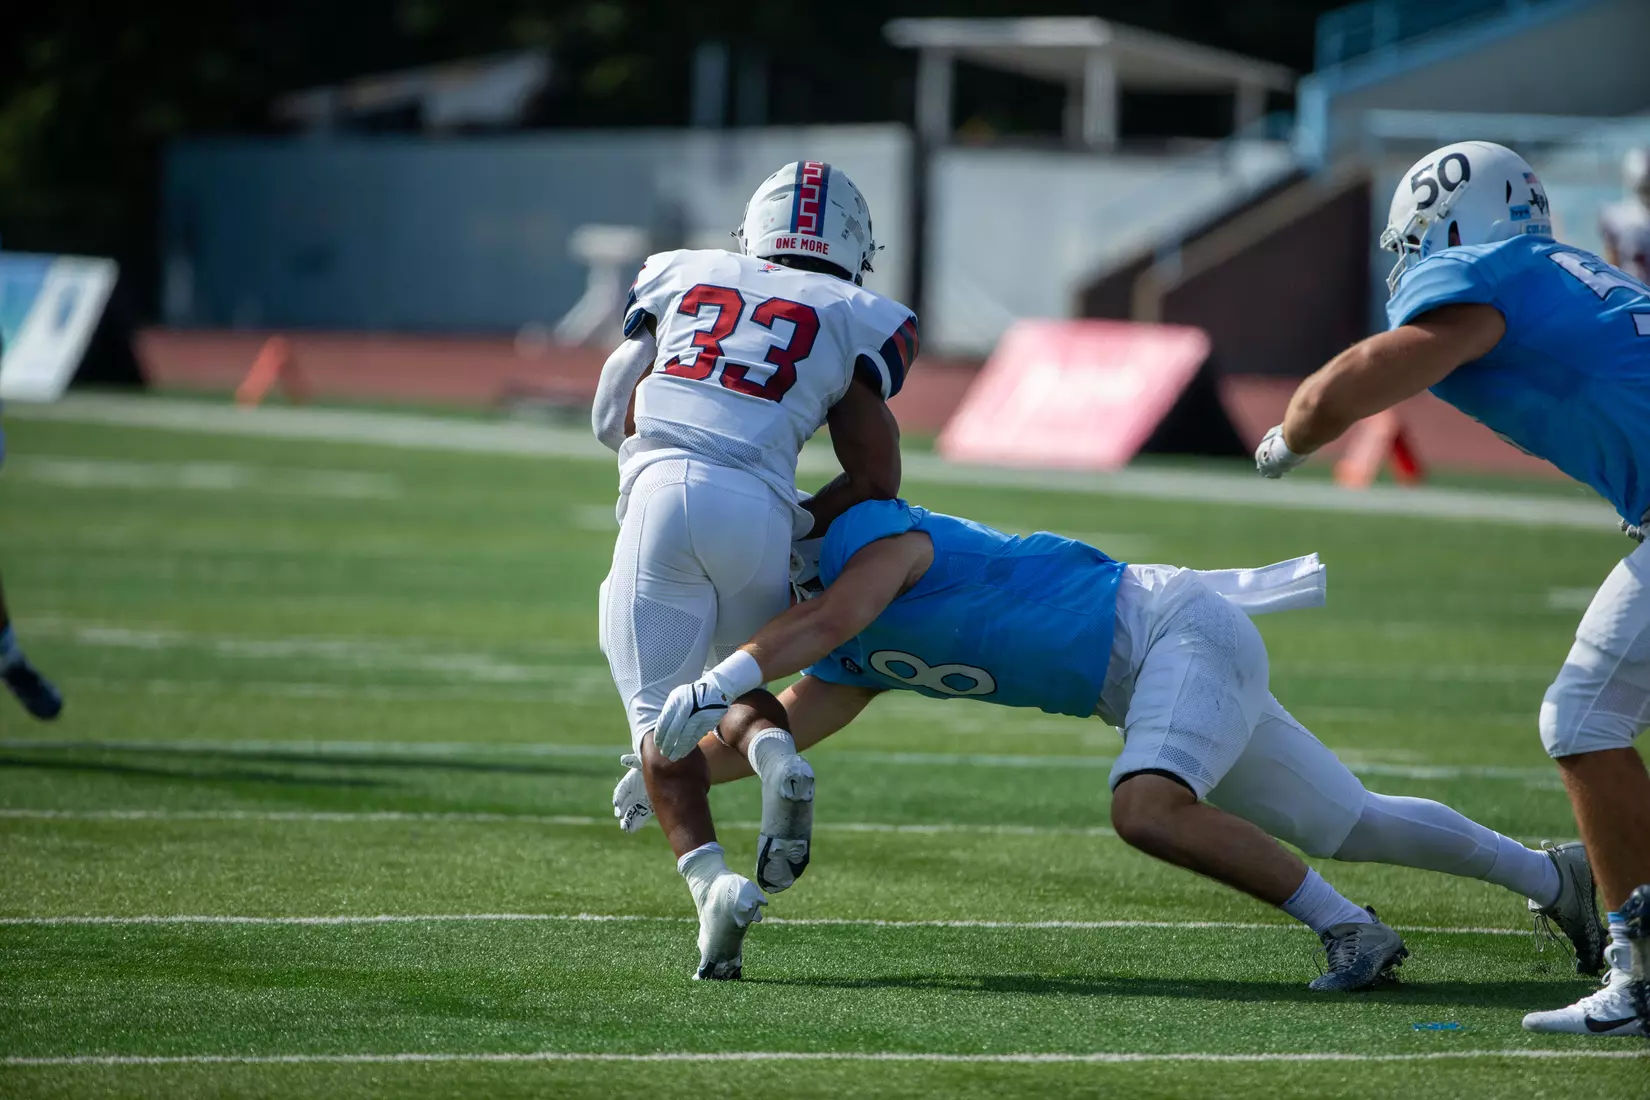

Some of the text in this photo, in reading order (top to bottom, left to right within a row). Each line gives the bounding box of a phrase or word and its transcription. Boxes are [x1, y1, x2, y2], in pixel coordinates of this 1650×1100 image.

[1410, 152, 1471, 211] 50
[775, 237, 829, 255] ONE MORE
[655, 283, 821, 403] 33
